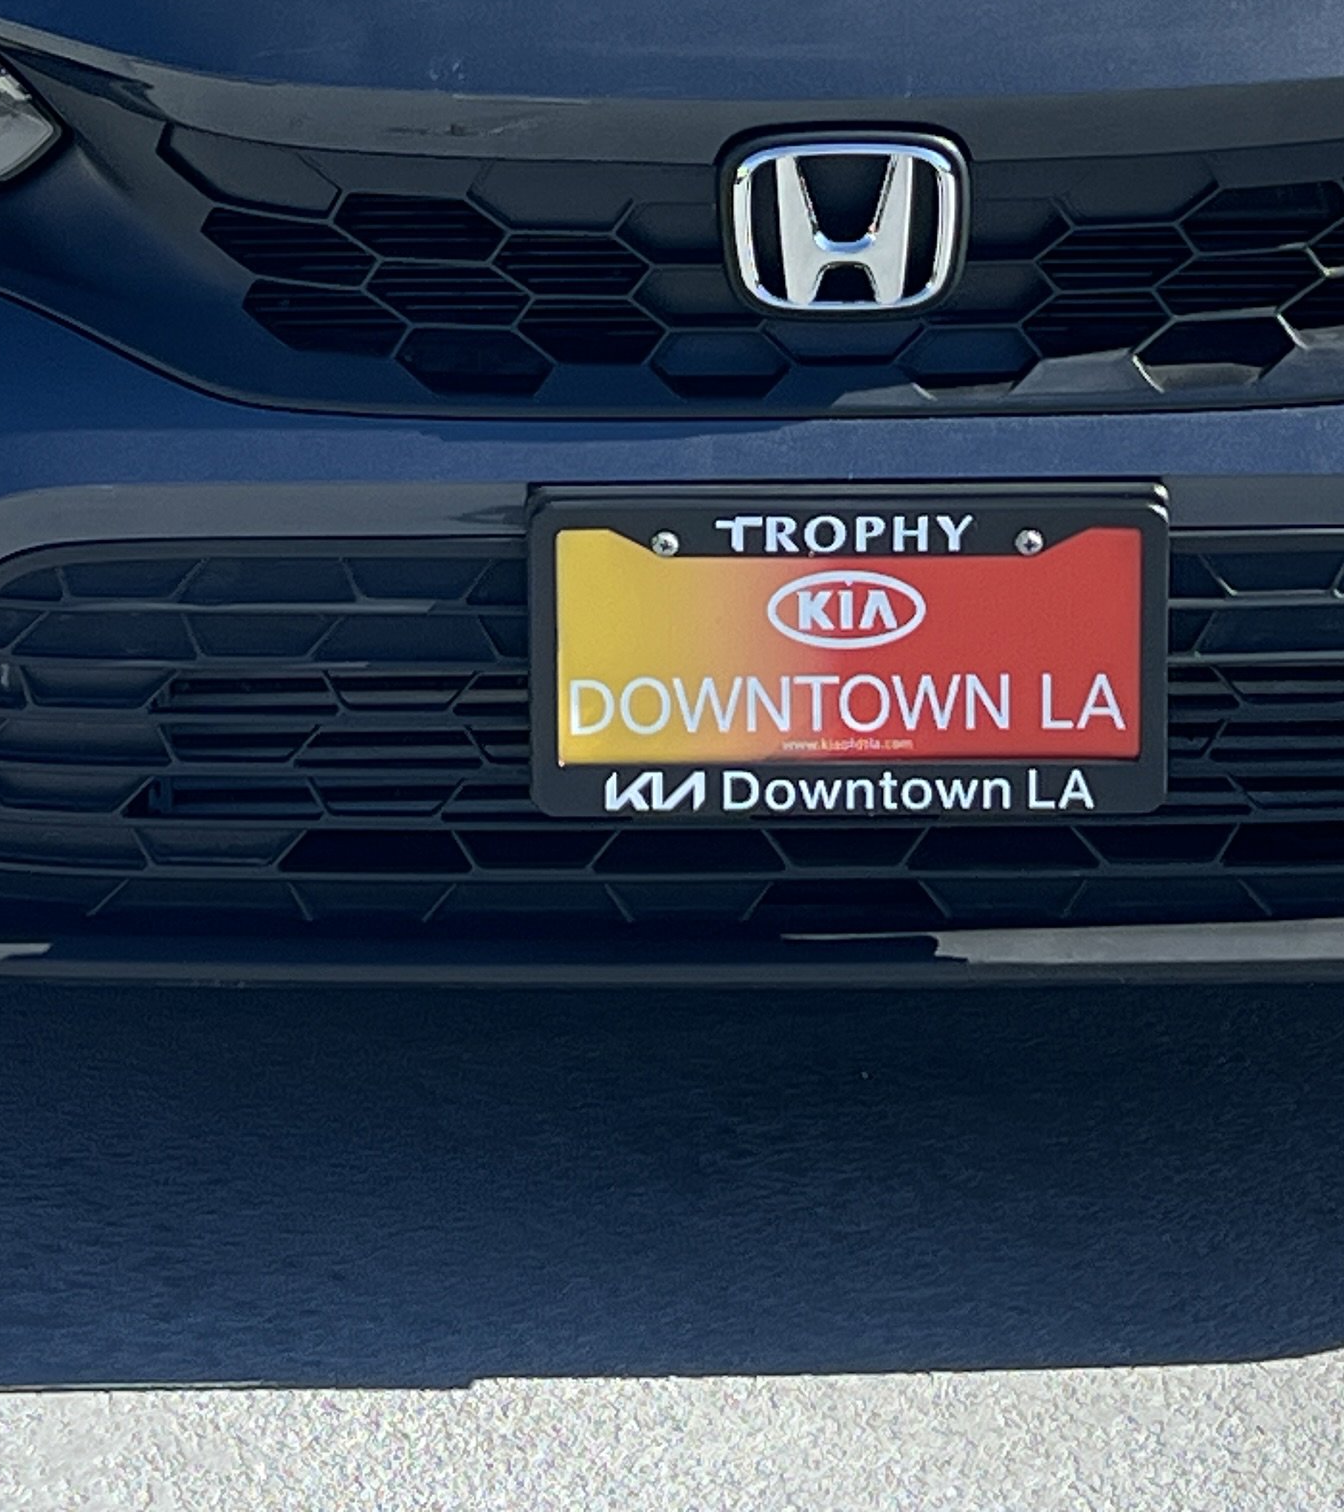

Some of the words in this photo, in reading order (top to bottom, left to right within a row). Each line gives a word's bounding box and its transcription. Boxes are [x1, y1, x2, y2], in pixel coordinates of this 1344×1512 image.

[714, 515, 974, 553] TROPHY
[797, 590, 899, 630] KIA
[568, 673, 1011, 736] DOWNTOWN
[1040, 673, 1127, 731] LA
[605, 771, 706, 811] KIA
[723, 771, 1012, 811] Downtown
[1028, 769, 1095, 809] LA
